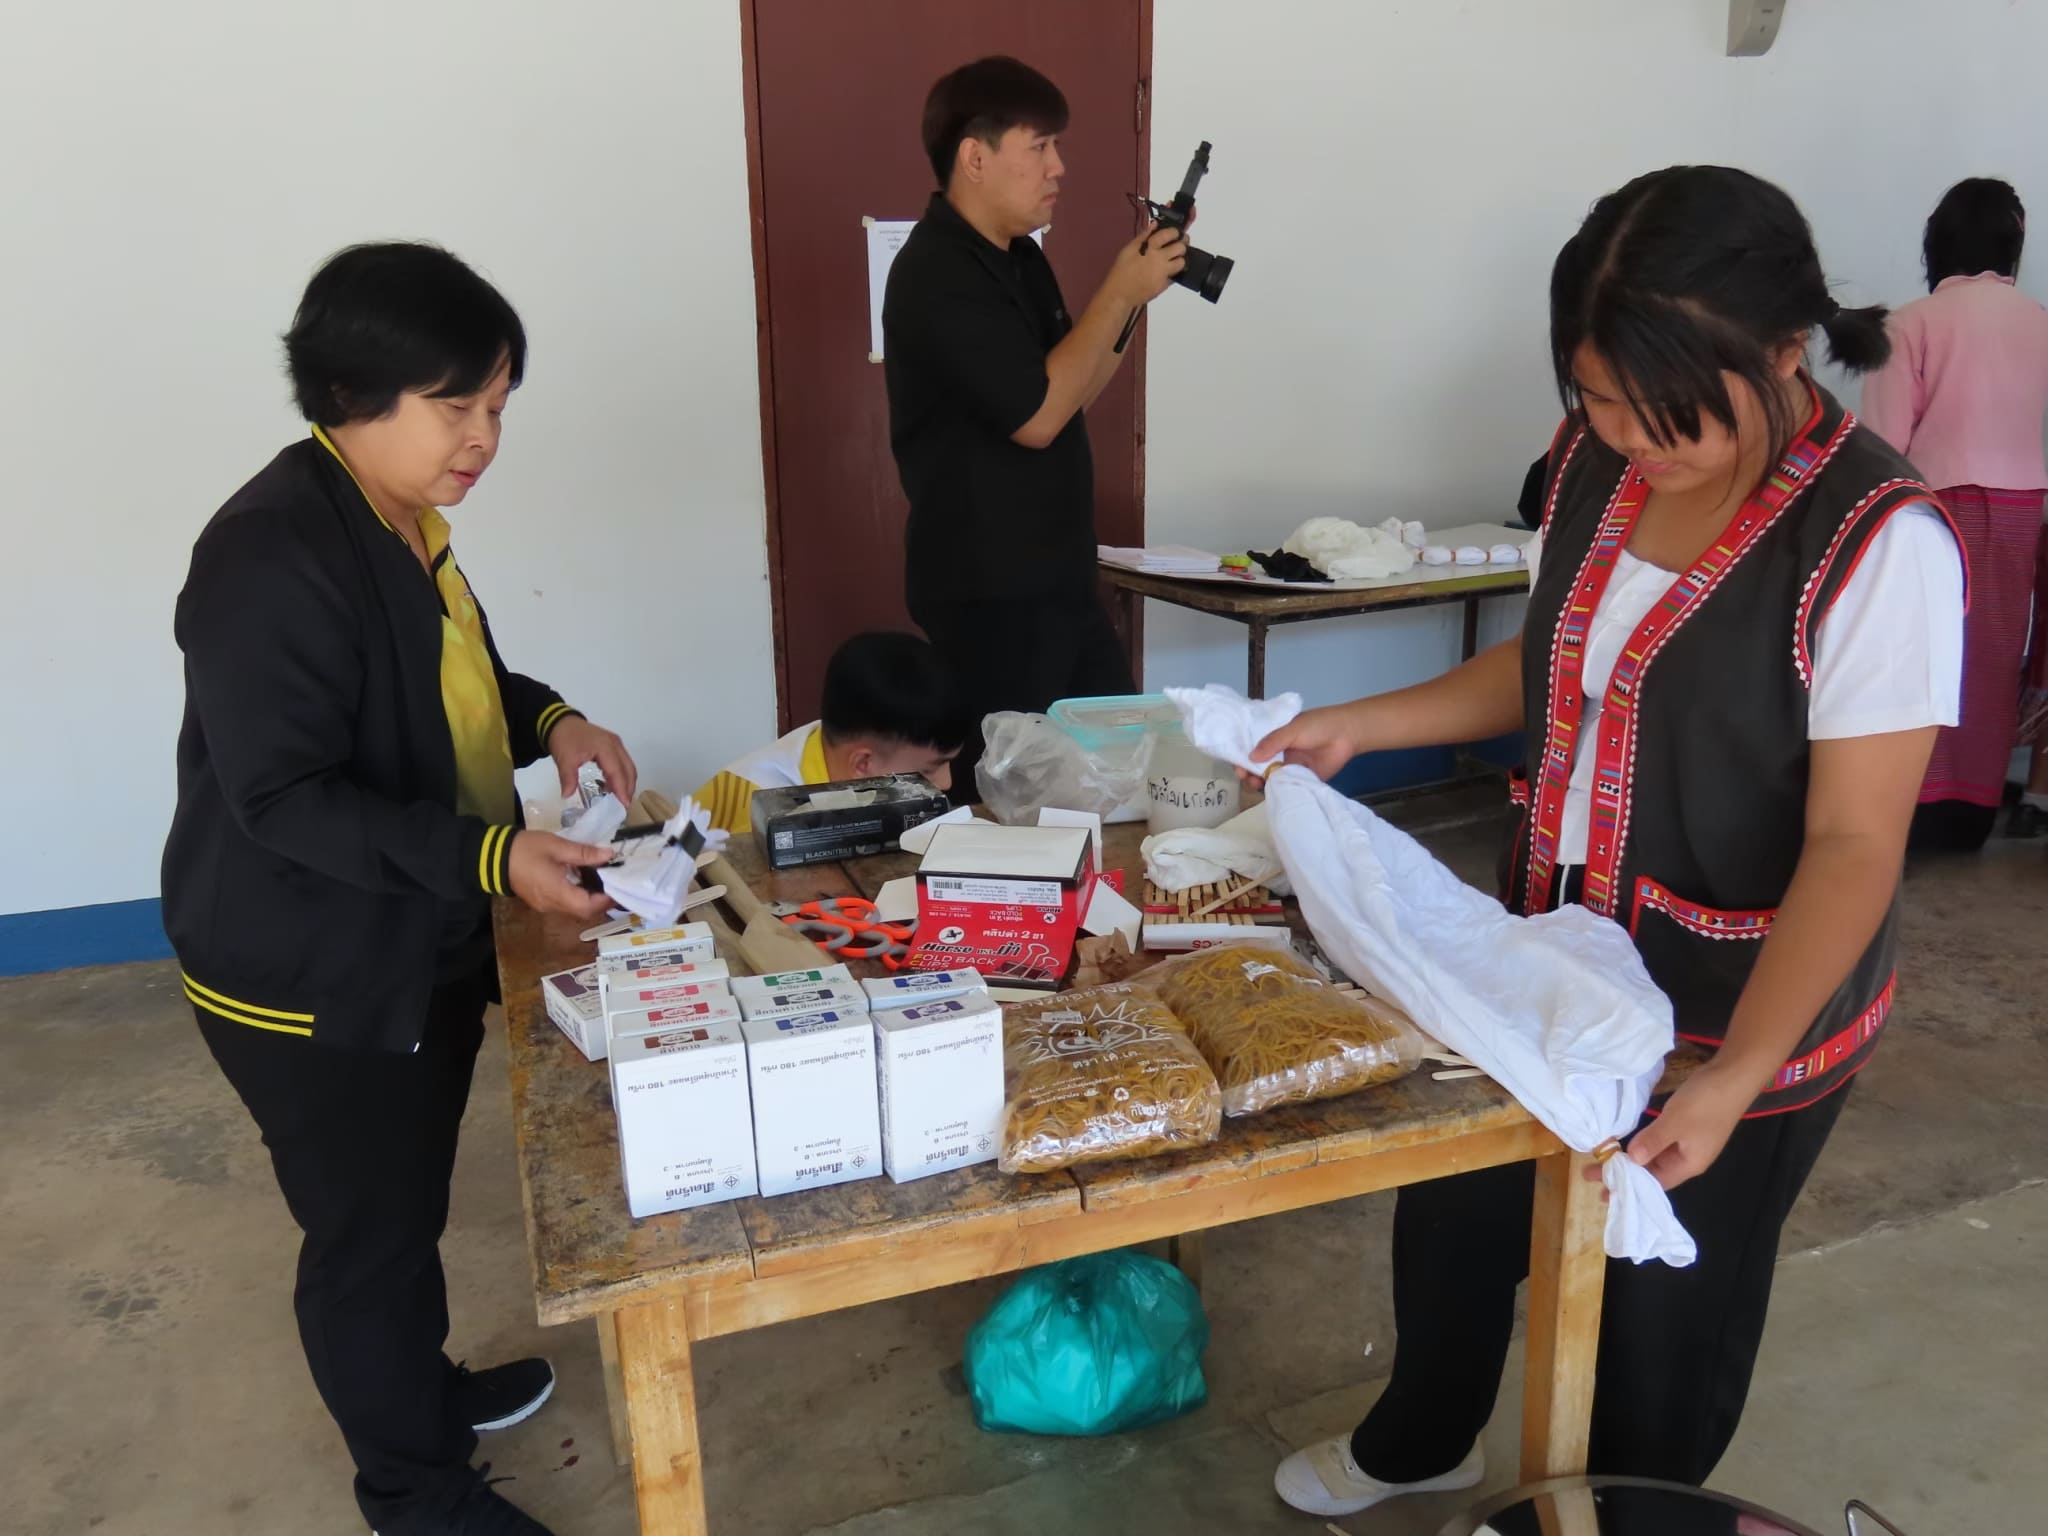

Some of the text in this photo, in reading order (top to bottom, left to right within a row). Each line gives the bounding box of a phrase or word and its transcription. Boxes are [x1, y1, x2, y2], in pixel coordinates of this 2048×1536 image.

[982, 928, 1045, 940] คลิปดำ 2 ขา
[917, 942, 974, 955] Horse
[909, 960, 949, 969] CLIPS
[912, 954, 998, 966] FOLD BACK
